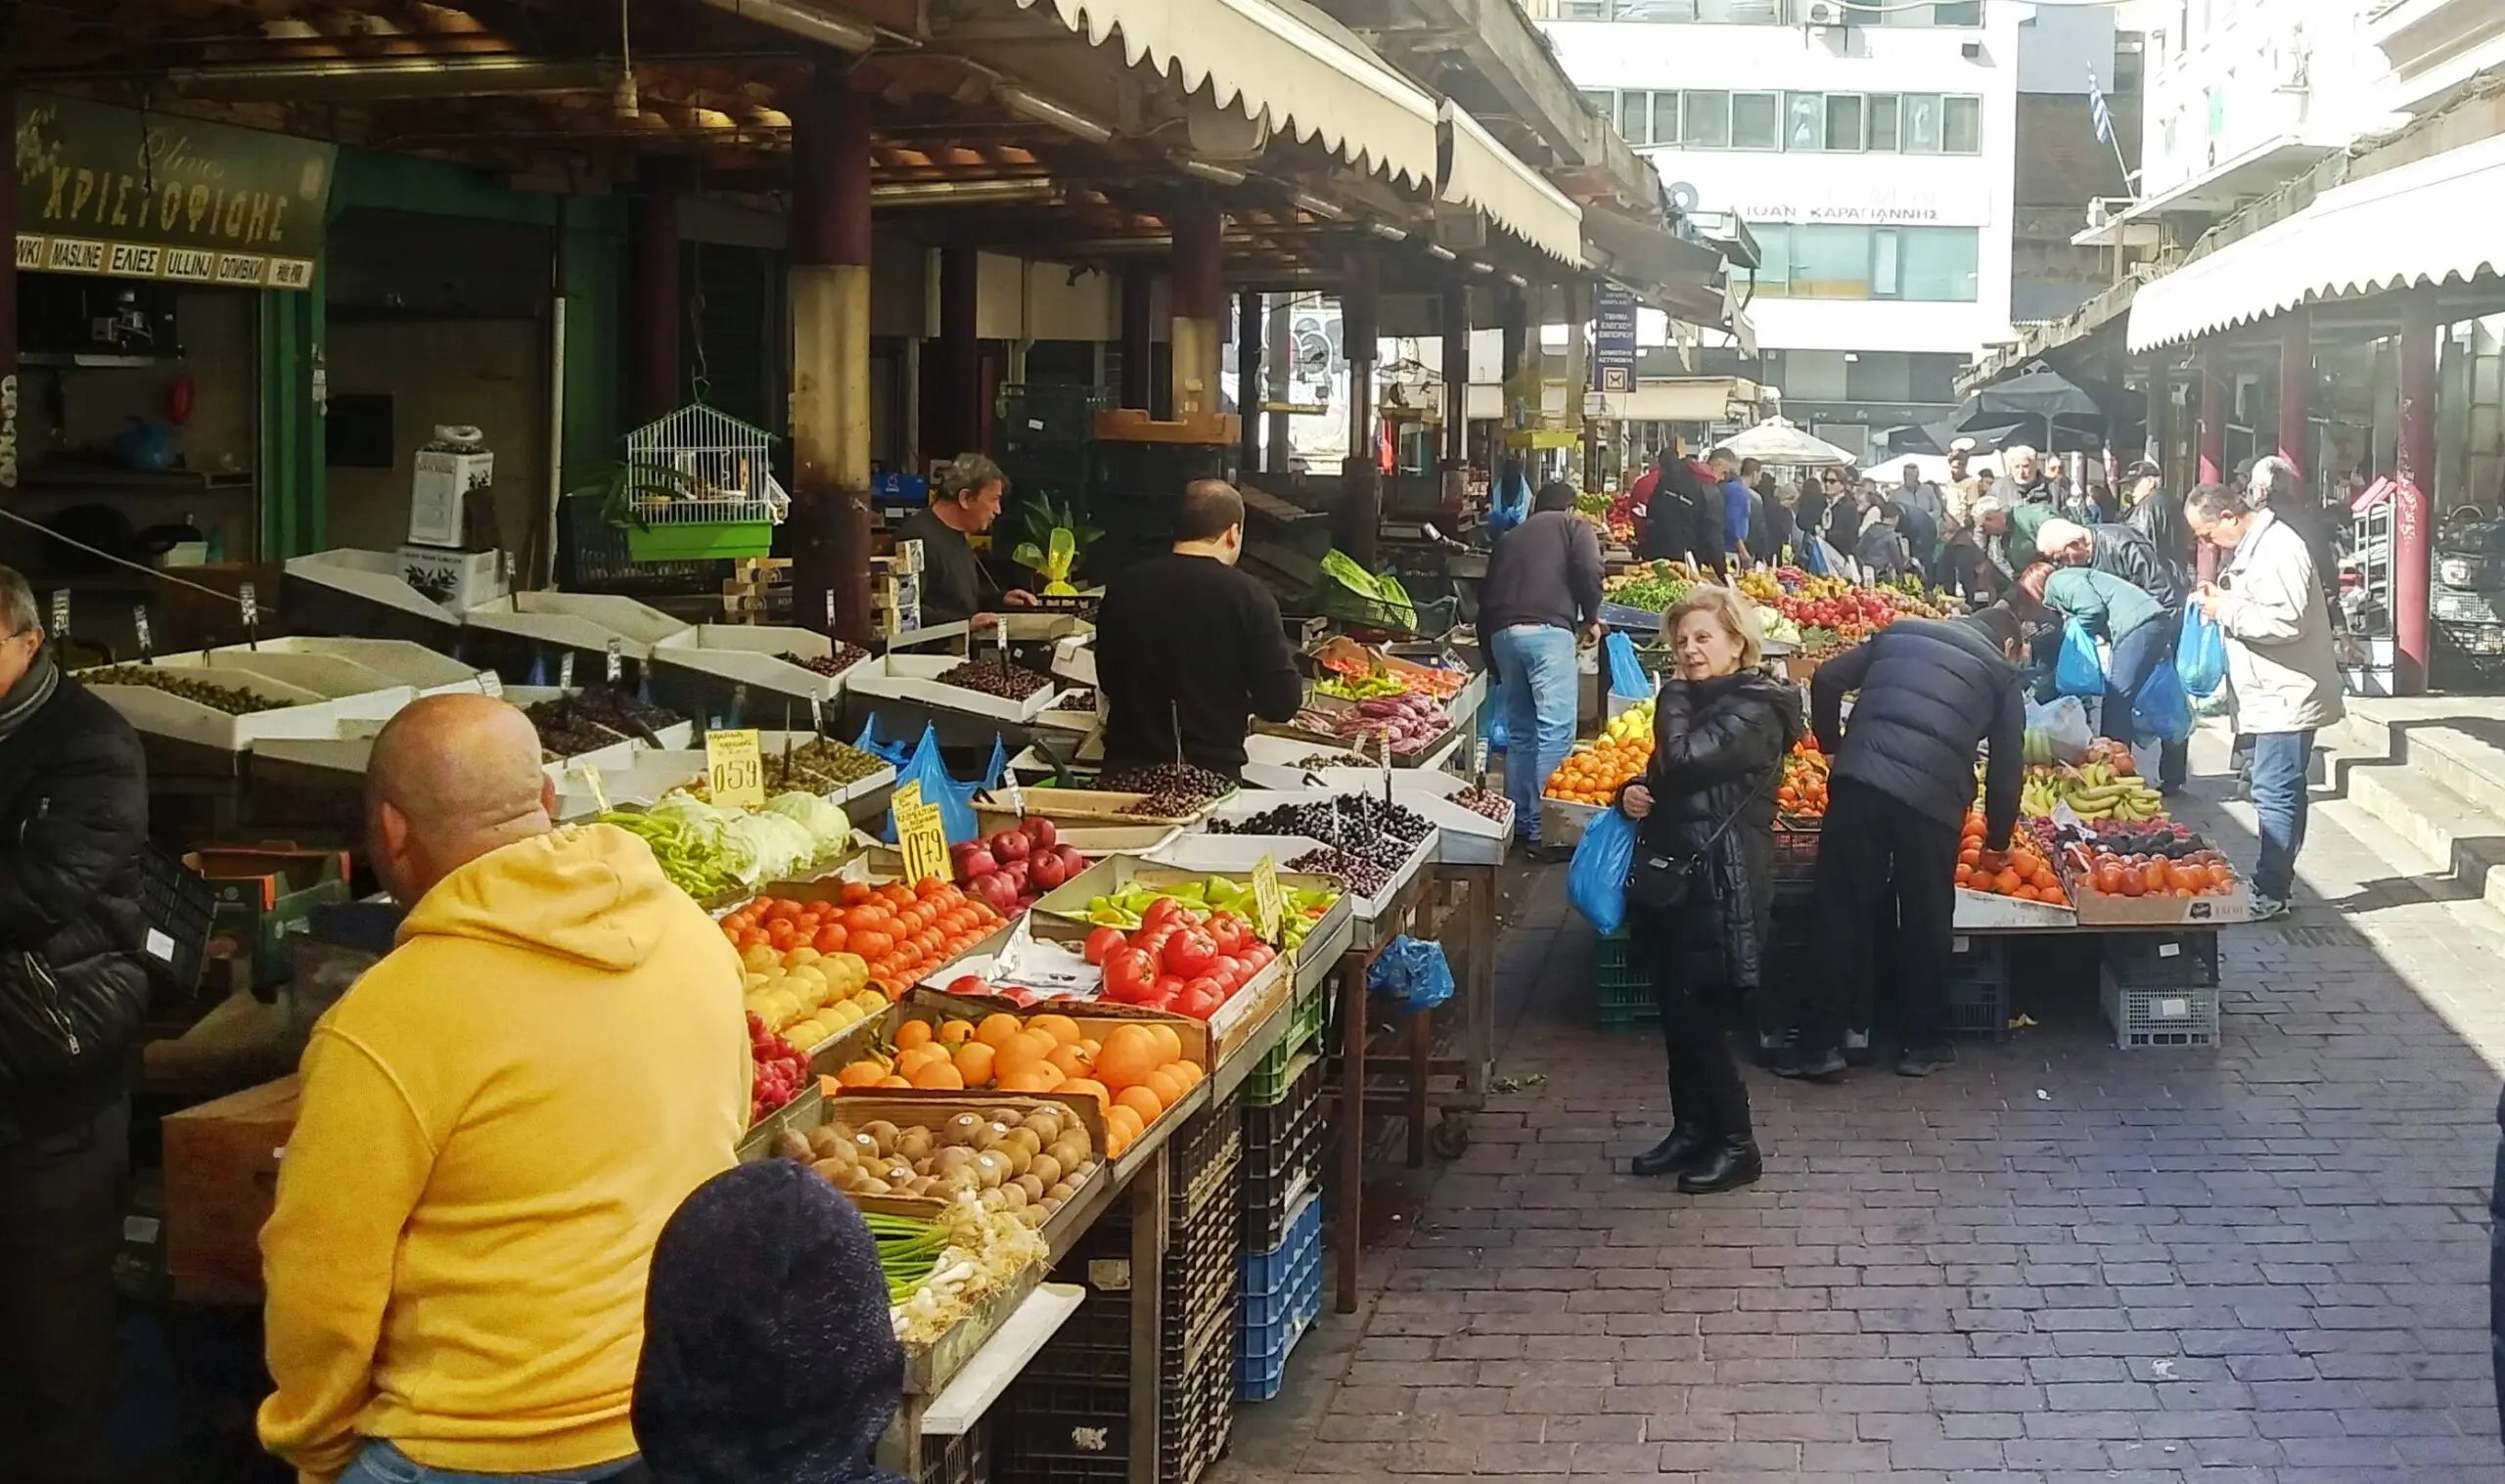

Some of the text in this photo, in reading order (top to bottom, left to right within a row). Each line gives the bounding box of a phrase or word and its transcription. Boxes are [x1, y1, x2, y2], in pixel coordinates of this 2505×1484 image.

[53, 243, 102, 269] MASLINE
[112, 247, 158, 273] ΕΛΙΕΣ
[167, 251, 212, 277] ULLINJ
